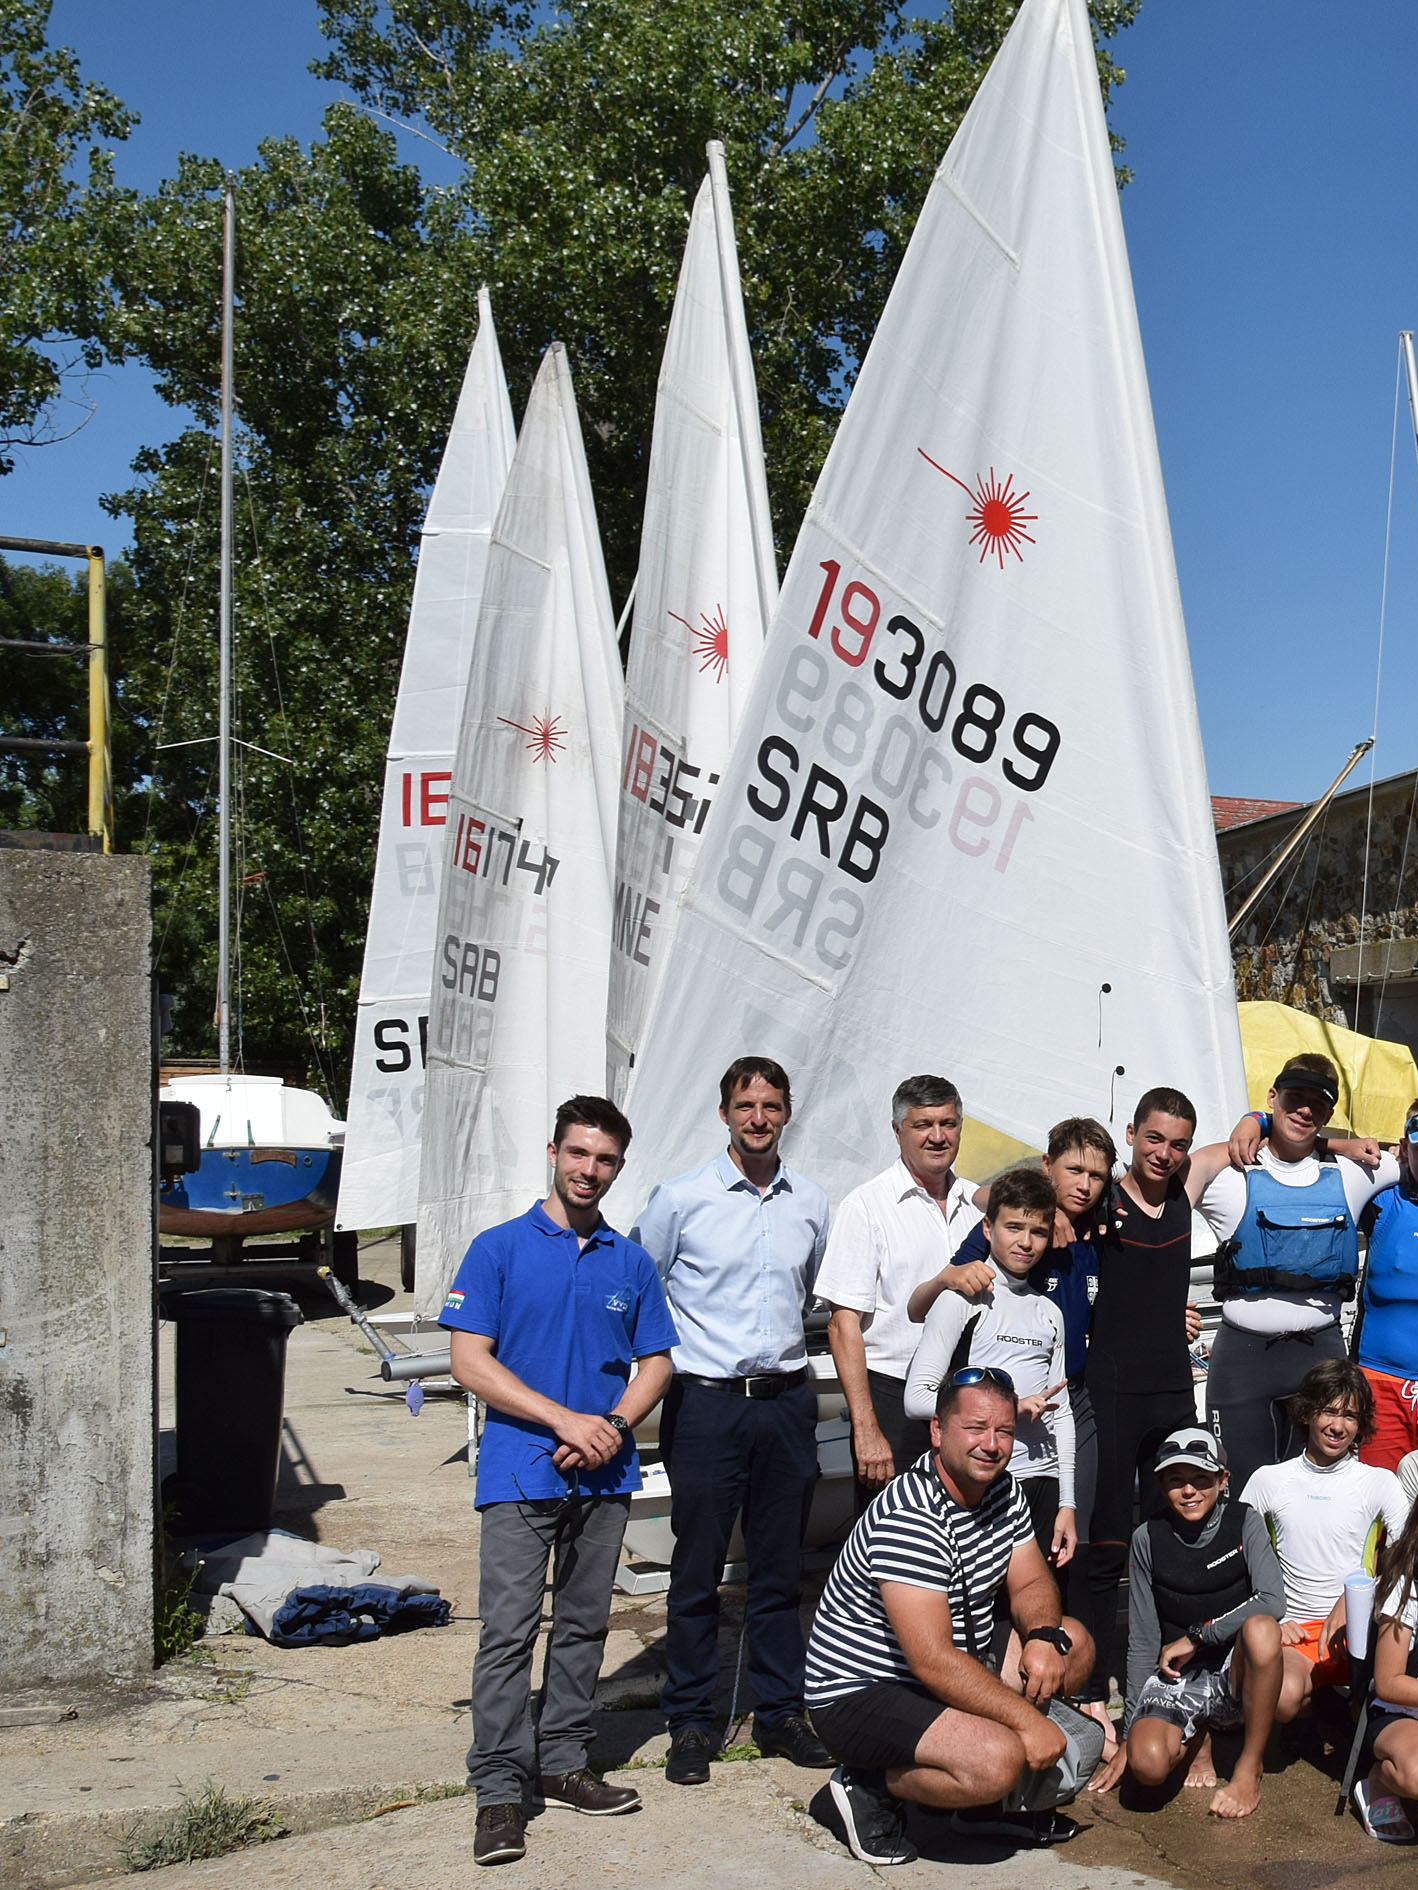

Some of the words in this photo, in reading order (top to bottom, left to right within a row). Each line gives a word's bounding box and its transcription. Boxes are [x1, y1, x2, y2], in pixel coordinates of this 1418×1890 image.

[808, 559, 1061, 792] 193089
[747, 735, 890, 884] SRB
[442, 934, 501, 1003] SRB
[996, 1334, 1043, 1348] ROOSTER
[1206, 1548, 1239, 1570] ROOSTER
